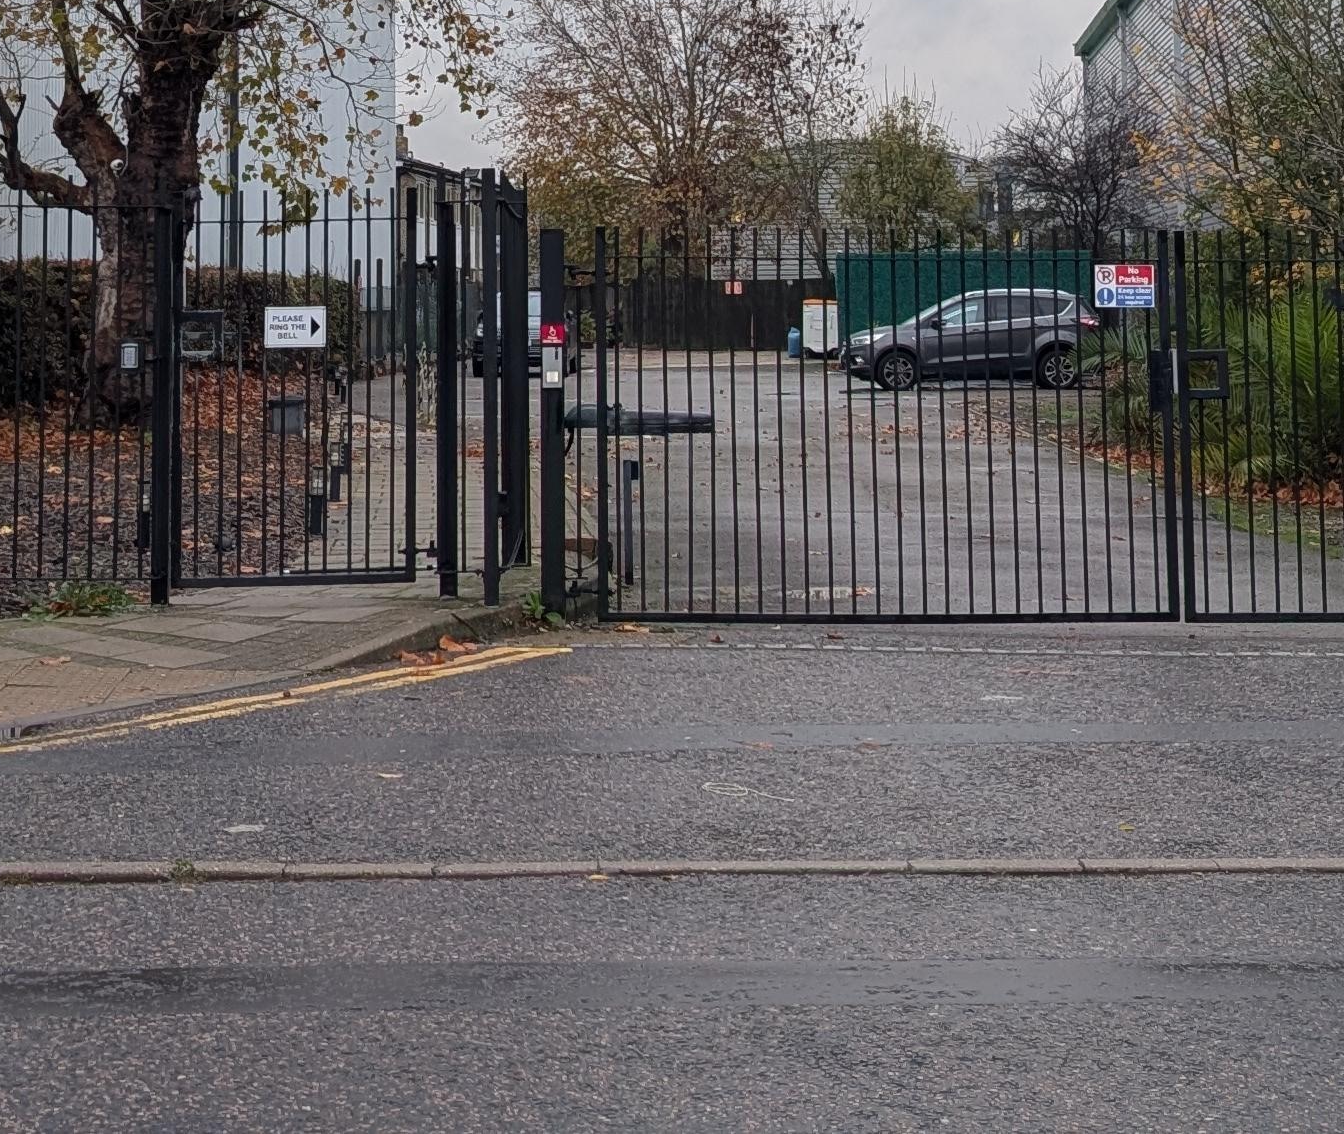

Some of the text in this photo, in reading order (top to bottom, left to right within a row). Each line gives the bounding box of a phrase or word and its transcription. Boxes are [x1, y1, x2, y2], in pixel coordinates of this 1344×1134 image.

[1127, 266, 1140, 275] No
[1118, 275, 1149, 285] Parking
[1117, 287, 1135, 295] Keep
[272, 314, 304, 323] PLEASE
[269, 323, 307, 331] RING THE
[277, 332, 298, 340] BELL
